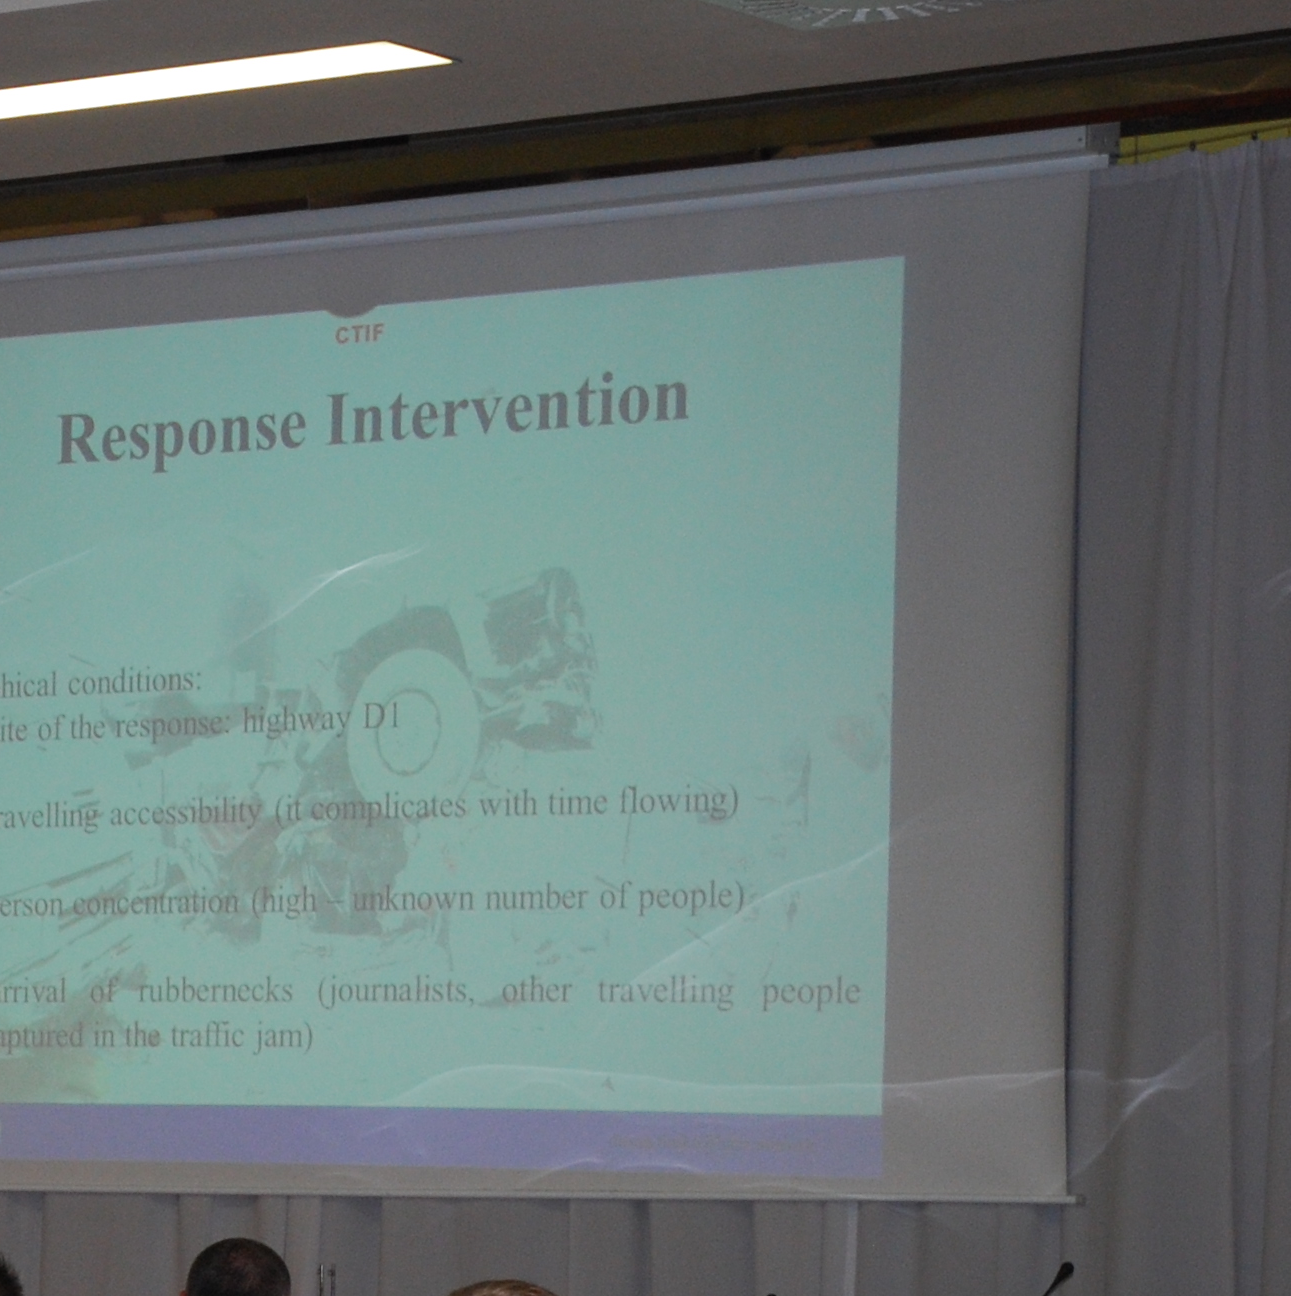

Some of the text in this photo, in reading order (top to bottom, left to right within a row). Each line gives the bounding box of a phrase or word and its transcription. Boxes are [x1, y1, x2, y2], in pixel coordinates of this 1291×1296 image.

[335, 323, 384, 344] CTIF
[57, 371, 689, 472] Response Intervention
[68, 666, 203, 696] conditions:
[37, 714, 63, 742] of
[70, 713, 106, 740] the
[115, 715, 230, 750] response:
[242, 706, 351, 740] highway
[364, 702, 399, 730] D1
[109, 797, 261, 831] accessibility
[275, 797, 302, 828] (it
[311, 791, 467, 827] complicates
[479, 787, 538, 818] with
[548, 786, 608, 816] time
[620, 784, 740, 823] flowing)
[72, 890, 239, 917] concentration
[251, 885, 318, 920] (high
[353, 884, 474, 915] unknown
[485, 883, 589, 910] number
[599, 881, 632, 909] of
[637, 879, 746, 917] people)
[90, 976, 118, 1004] of
[138, 975, 294, 1003] rubbernecks
[318, 974, 475, 1010] (journalists,
[501, 974, 572, 1004] other
[598, 974, 734, 1011] travelling
[761, 974, 860, 1011] people
[94, 1021, 116, 1048] in
[125, 1020, 161, 1048] the
[171, 1020, 245, 1048] traffic
[253, 1020, 313, 1055] jam)
